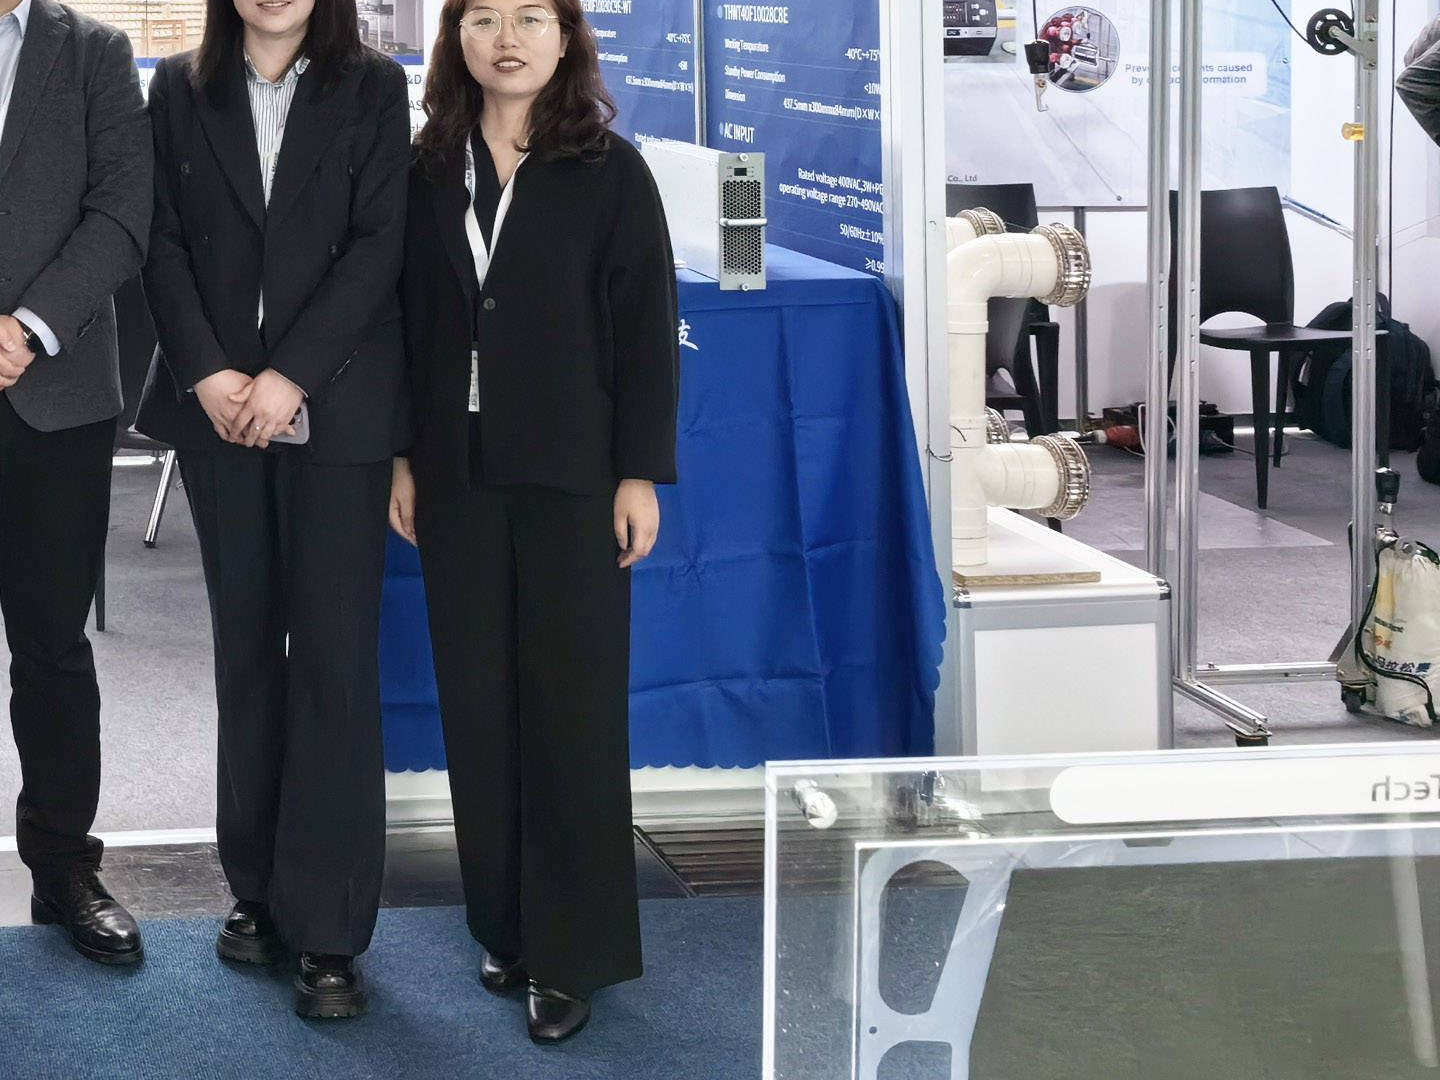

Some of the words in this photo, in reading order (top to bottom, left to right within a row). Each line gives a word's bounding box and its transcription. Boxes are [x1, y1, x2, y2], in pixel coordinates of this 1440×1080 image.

[1217, 63, 1253, 72] caused
[1132, 76, 1143, 85] by
[724, 122, 734, 139] AC
[734, 124, 755, 143] INPUT
[798, 167, 815, 182] Rated
[815, 171, 838, 188] voltage
[779, 183, 806, 200] operating
[806, 187, 828, 204] voltage
[828, 193, 846, 208] range
